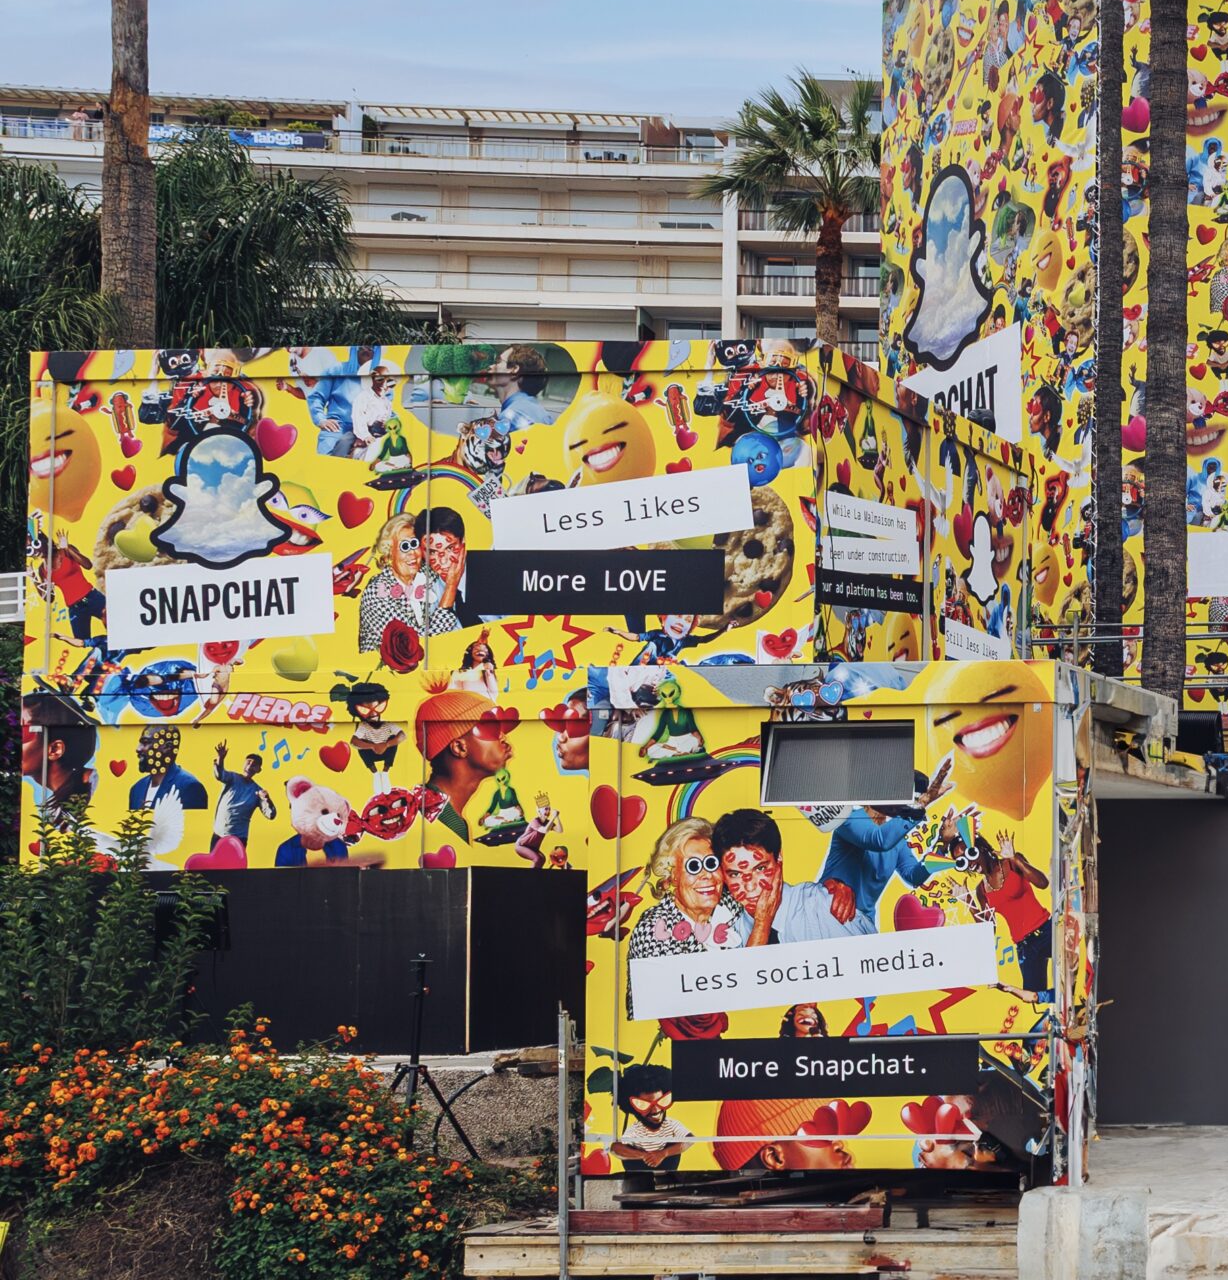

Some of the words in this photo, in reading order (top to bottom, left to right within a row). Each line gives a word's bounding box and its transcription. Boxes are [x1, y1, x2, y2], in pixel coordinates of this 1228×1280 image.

[251, 132, 303, 145] Taboola
[543, 510, 604, 534] Less
[624, 495, 700, 522] likes
[832, 504, 851, 519] While
[853, 509, 862, 521] La
[864, 510, 895, 528] Malmaison
[897, 517, 907, 531] has
[830, 548, 845, 561] been
[848, 549, 865, 561] under
[868, 549, 910, 565] construction,
[522, 569, 586, 592] More
[604, 569, 667, 592] LOVE
[836, 582, 844, 594] ad
[846, 582, 875, 598] platform
[877, 586, 888, 600] has
[890, 588, 904, 601] been
[906, 591, 919, 603] too.
[139, 577, 300, 626] SNAPCHAT
[946, 630, 963, 648] Still
[966, 637, 980, 654] less
[227, 692, 333, 734] FIERCE
[681, 972, 738, 993] Less
[756, 956, 844, 985] social
[861, 948, 944, 975] media.
[719, 1057, 779, 1079] More
[795, 1053, 927, 1082] Snapchat.
